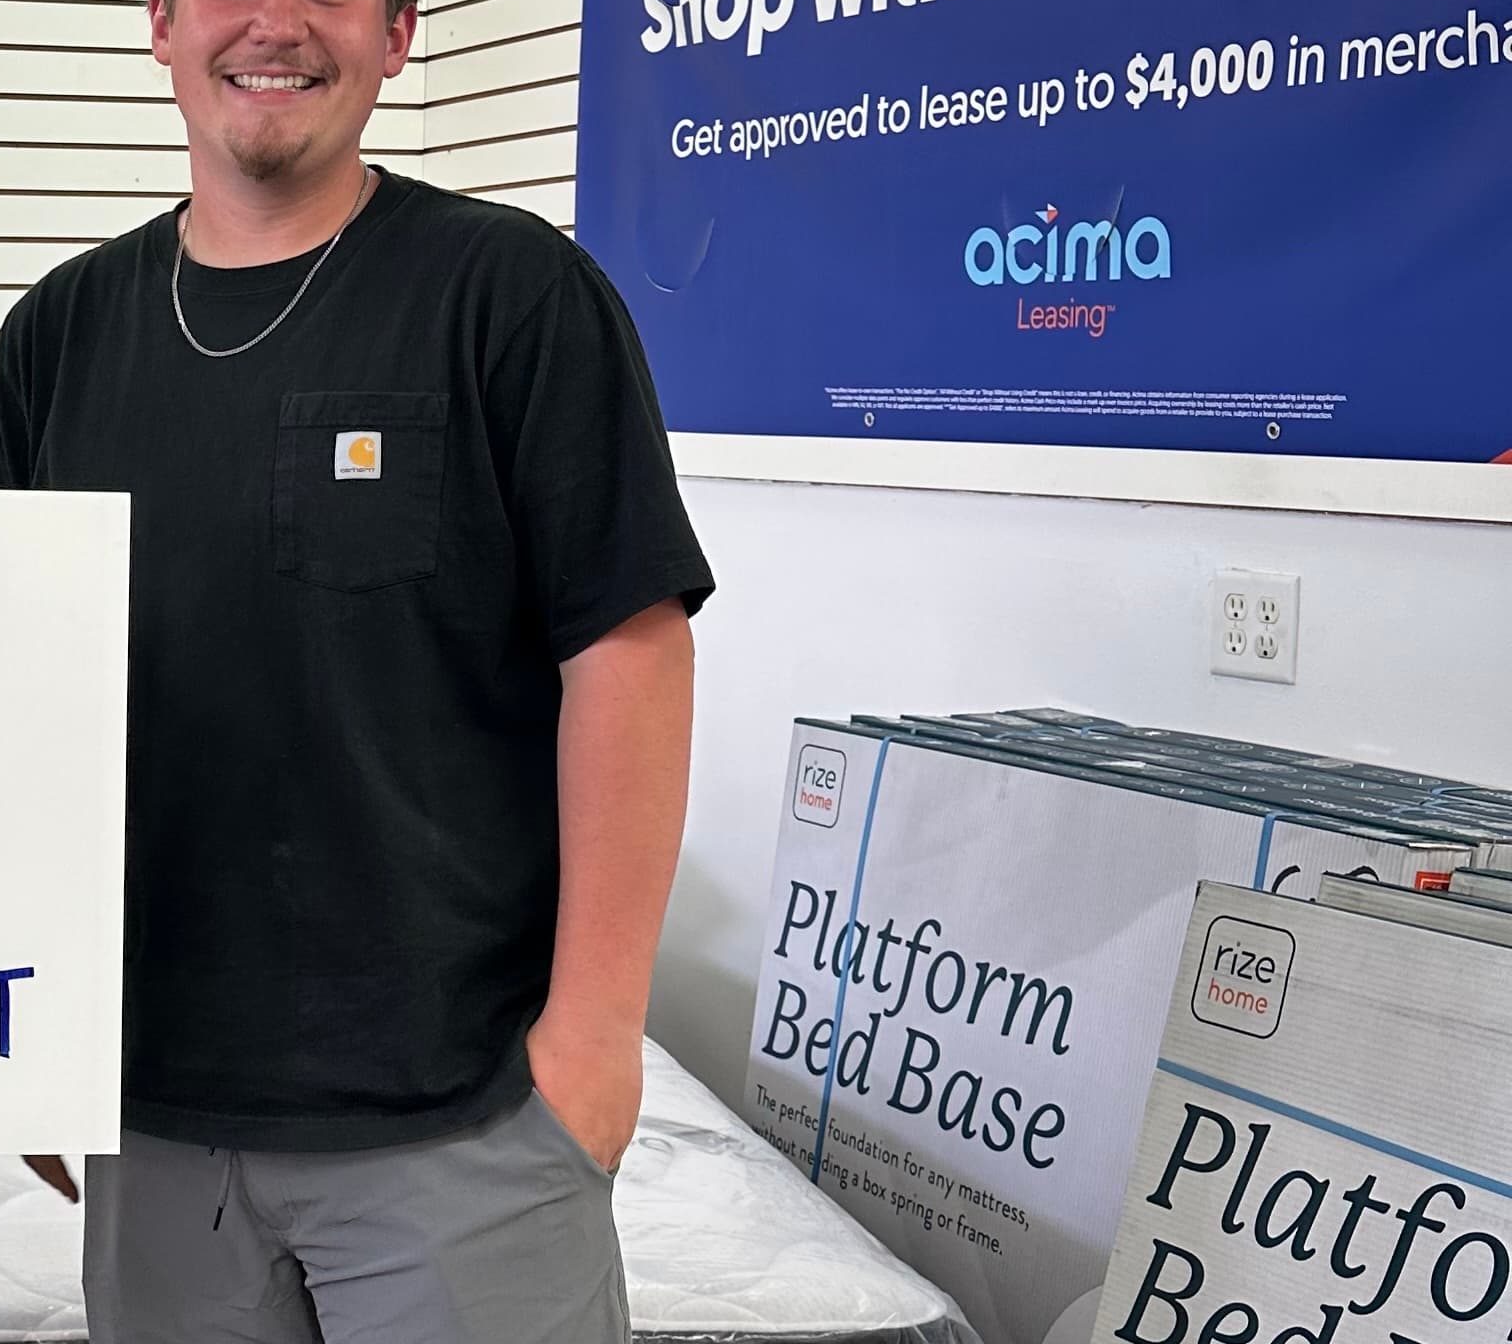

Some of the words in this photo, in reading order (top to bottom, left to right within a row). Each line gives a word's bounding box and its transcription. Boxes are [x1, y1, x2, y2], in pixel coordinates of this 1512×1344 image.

[671, 118, 723, 158] Get
[729, 93, 869, 160] approved
[877, 96, 910, 134] to
[919, 85, 1008, 130] lease
[1017, 77, 1065, 126] up
[1075, 69, 1115, 111] to
[1125, 39, 1274, 110] $4,000
[1287, 34, 1325, 87] in
[964, 204, 1171, 286] acima
[799, 789, 833, 812] home
[803, 760, 837, 790] rize
[773, 880, 1073, 1056] Platform
[1207, 977, 1268, 1016] home
[1214, 941, 1276, 984] rize
[762, 979, 881, 1096] Bed
[887, 1027, 1066, 1169] Base
[757, 1084, 776, 1111] The
[779, 1103, 821, 1131] perfec
[827, 1117, 899, 1168] foundation
[903, 1151, 925, 1178] for
[928, 1171, 954, 1199] any
[959, 1184, 1029, 1232] mattress,
[799, 1148, 848, 1190] neding
[851, 1174, 859, 1186] a
[863, 1170, 887, 1200] box
[890, 1191, 934, 1231] spring
[937, 1214, 953, 1230] or
[957, 1214, 1003, 1256] frame.
[1146, 1102, 1512, 1342] Platfo
